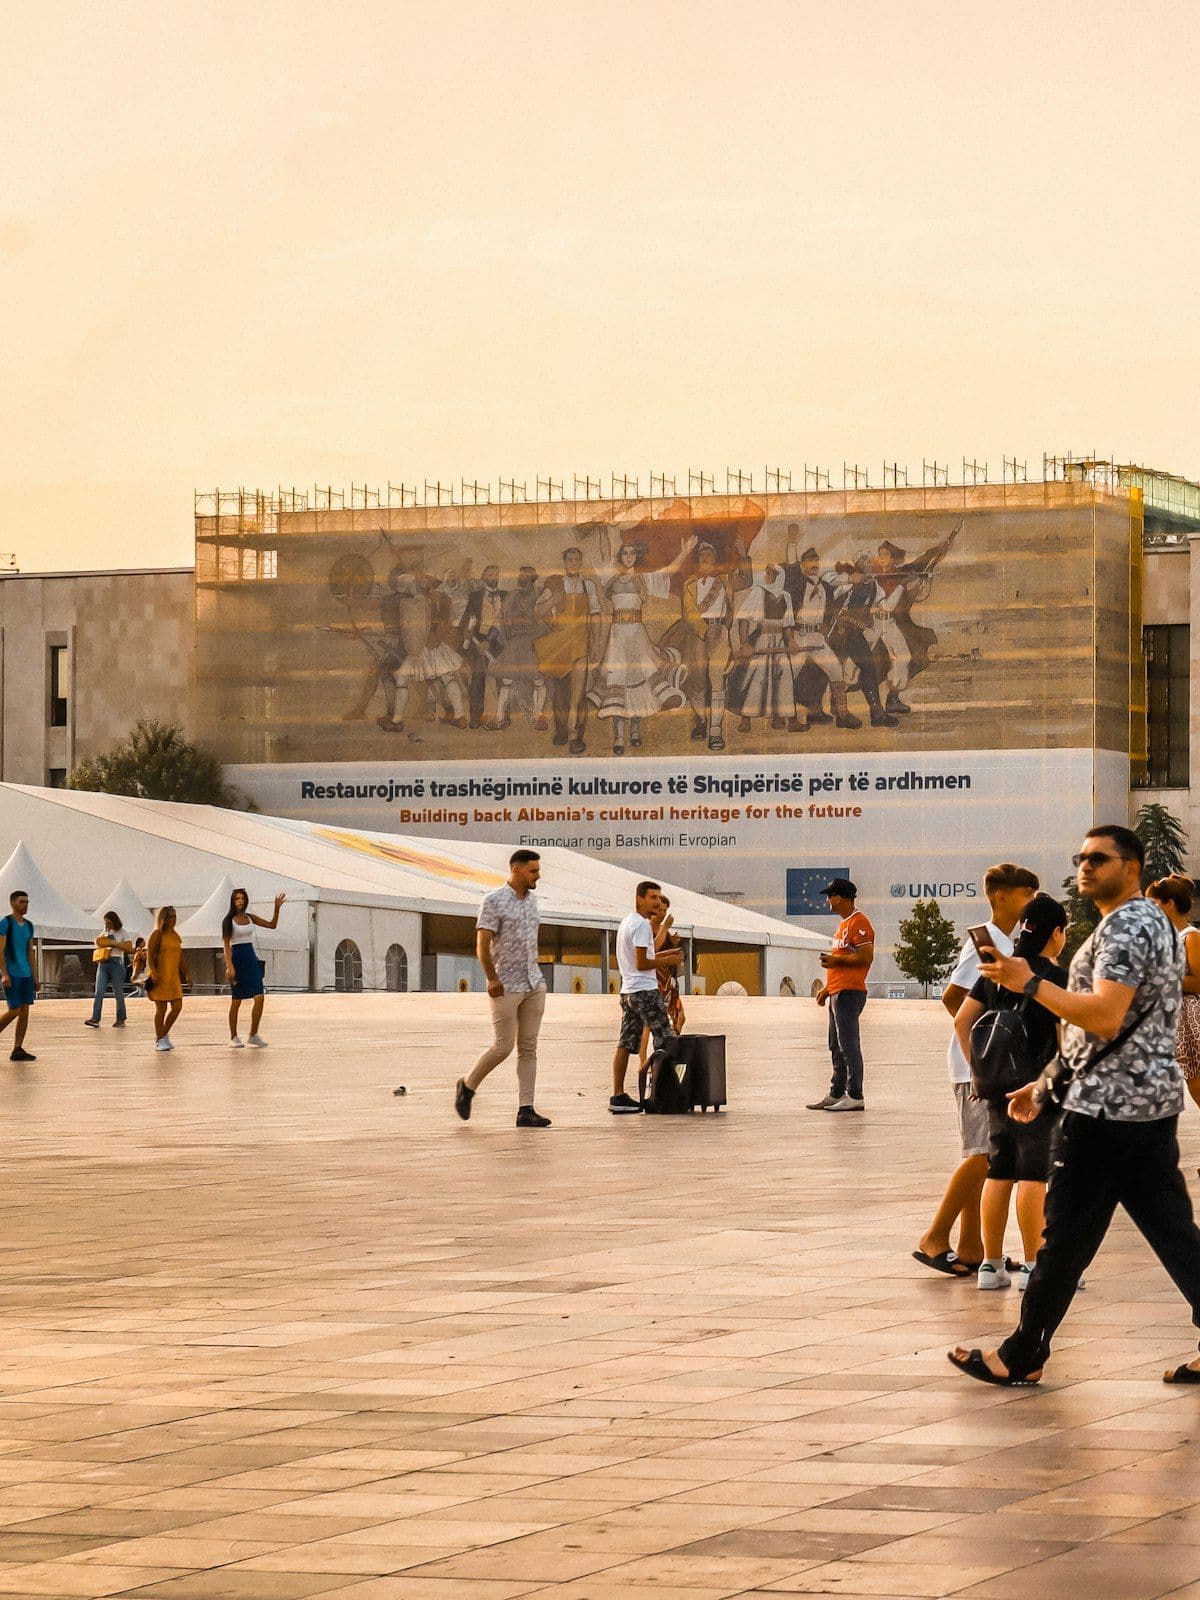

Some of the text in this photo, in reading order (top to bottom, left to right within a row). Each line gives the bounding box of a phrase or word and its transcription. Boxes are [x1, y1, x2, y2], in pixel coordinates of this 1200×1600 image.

[301, 771, 972, 802] Restaurojmë trashëgiminë kulturore të Shqipërisë për të ardhmen
[400, 809, 468, 826] Building
[474, 808, 512, 823] back
[599, 806, 664, 821] cultural
[669, 805, 741, 823] heritage
[745, 805, 770, 819] for
[775, 804, 803, 819] the
[808, 804, 862, 818] future
[519, 832, 737, 850] Financuar nga Bashkimi Evropian
[909, 883, 977, 898] UNOPS
